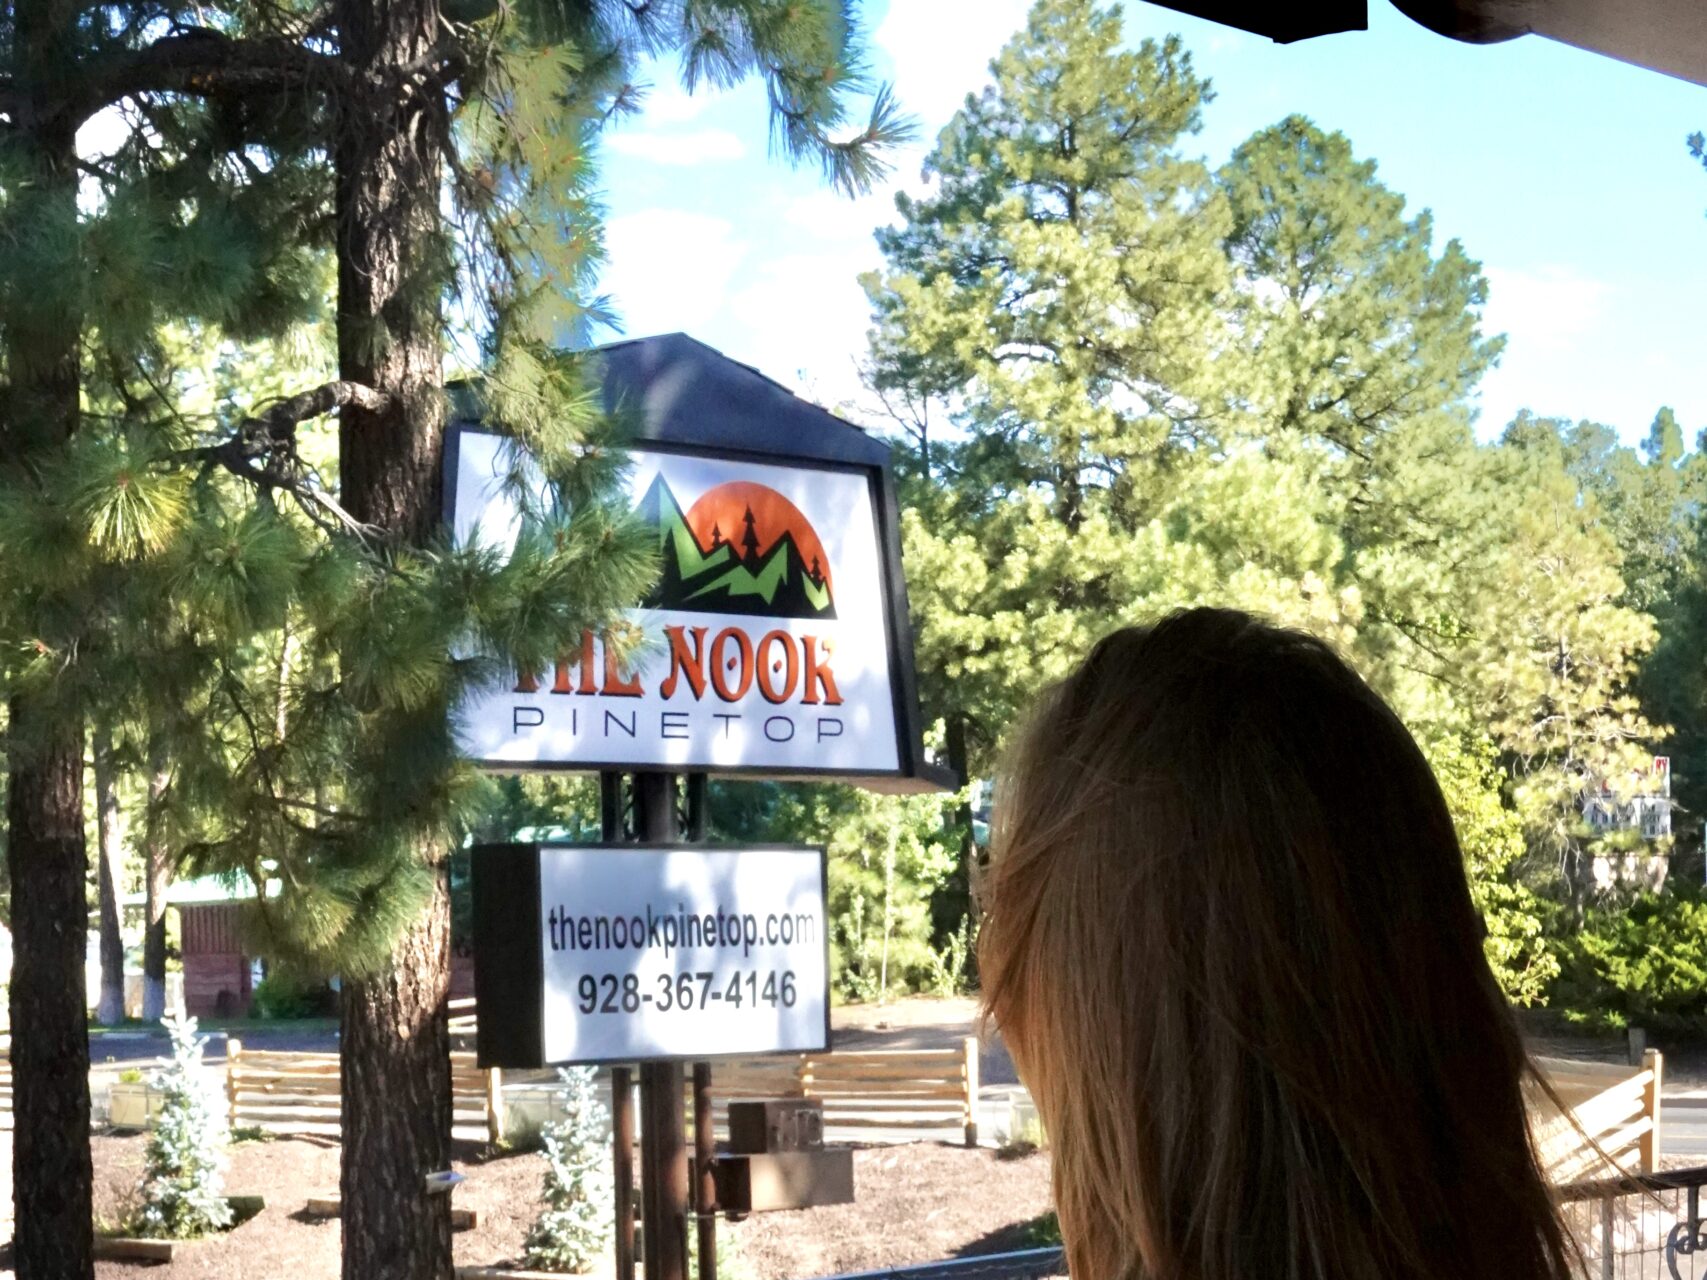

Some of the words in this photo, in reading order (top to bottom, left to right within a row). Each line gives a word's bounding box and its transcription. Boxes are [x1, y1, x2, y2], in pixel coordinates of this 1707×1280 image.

[660, 624, 844, 706] NOOK
[512, 706, 844, 743] PINETOP
[549, 903, 815, 959] thenookpinetop.com
[578, 969, 797, 1014] 928-367-4146
